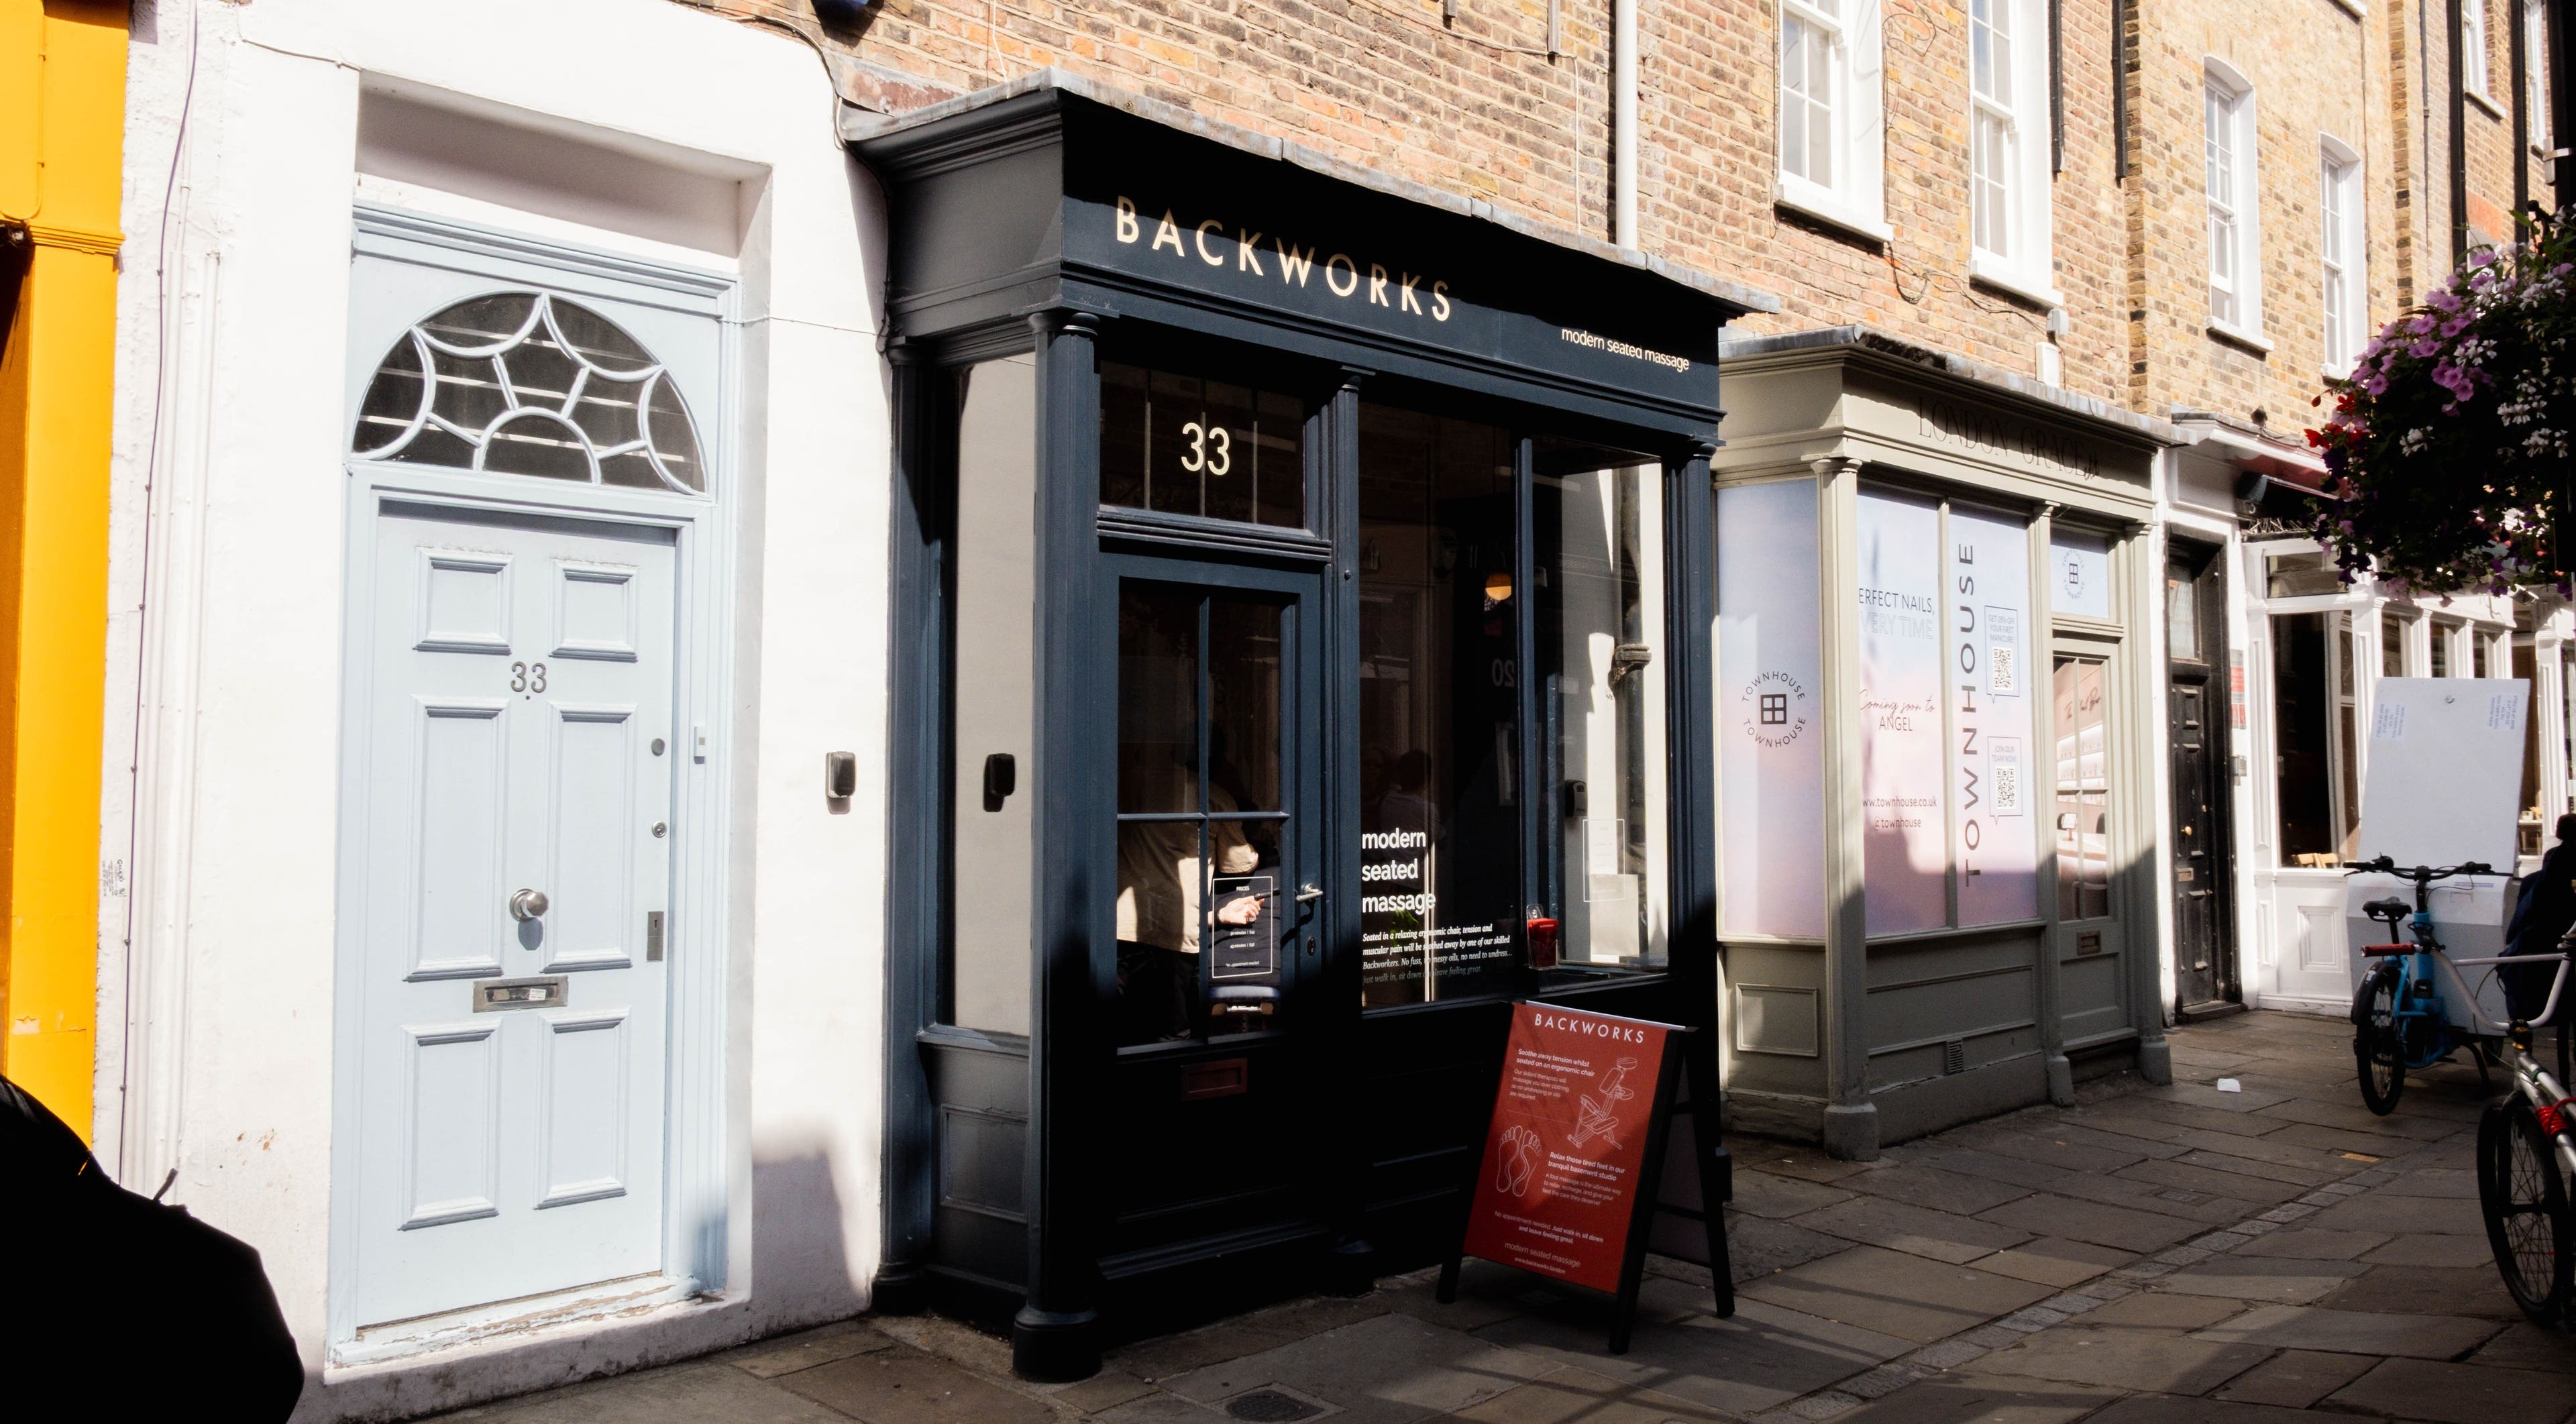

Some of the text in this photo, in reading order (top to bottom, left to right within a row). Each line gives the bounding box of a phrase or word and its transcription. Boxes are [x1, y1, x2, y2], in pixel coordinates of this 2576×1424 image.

[1116, 195, 1452, 322] BACKWORKS
[1562, 329, 1689, 372] modern seated massage
[1918, 397, 2008, 458] LONDON
[2021, 427, 2086, 477] GRACE
[1181, 423, 1230, 475] 33
[1859, 588, 1935, 616] ERFECT NAILS,
[1860, 610, 1933, 639] VERY TIME
[511, 661, 547, 693] 33
[1741, 671, 1805, 702] TOWNHOUSE
[1879, 716, 1913, 731] ANGEL
[1959, 543, 1981, 887] TOWNHOUSE
[1743, 718, 1806, 748] TOWNHOUSE
[1862, 796, 1937, 807] ww.townhouse.co.uk
[1874, 816, 1921, 830] @townhouse
[1362, 828, 1426, 849] modern
[1362, 859, 1418, 881] seated
[1362, 893, 1436, 915] massage
[1362, 933, 1381, 942] Seated
[1383, 932, 1389, 940] in
[1395, 930, 1417, 939] relaxing
[1447, 927, 1461, 936] chair,
[1463, 925, 1481, 934] tension
[1482, 924, 1493, 932] and
[1363, 945, 1389, 955] muscular
[1390, 945, 1402, 954] pain
[1404, 943, 1414, 952] will
[1415, 942, 1422, 951] be
[1444, 940, 1458, 950] away
[1460, 938, 1466, 948] by
[1478, 937, 1483, 947] of
[1494, 935, 1510, 944] skilled
[1363, 959, 1399, 970] Backworkers.
[1401, 958, 1409, 966] No
[1410, 957, 1422, 967] fuss,
[1449, 952, 1459, 962] oils,
[1469, 950, 1481, 960] need
[1488, 949, 1512, 958] undress...
[1363, 975, 1373, 984] just
[1375, 973, 1388, 982] walk
[1407, 969, 1421, 979] down
[1449, 965, 1466, 977] feeling
[1535, 1014, 1644, 1044] BACKWORKS
[1516, 1057, 1534, 1066] seated
[1551, 1064, 1580, 1075] ergonomic
[1581, 1069, 1595, 1077] chair
[1518, 1049, 1537, 1058] Soothe
[1552, 1055, 1572, 1064] tension
[1573, 1059, 1589, 1067] whilst
[1548, 1161, 1617, 1181] tranquil basement studio
[1550, 1152, 1565, 1160] Relax
[1566, 1156, 1581, 1164] those
[1583, 1159, 1596, 1167] tired
[1597, 1162, 1608, 1170] feet
[1529, 1227, 1542, 1236] leave
[1589, 1234, 1603, 1244] down
[1505, 1242, 1580, 1268] modern seated massage
